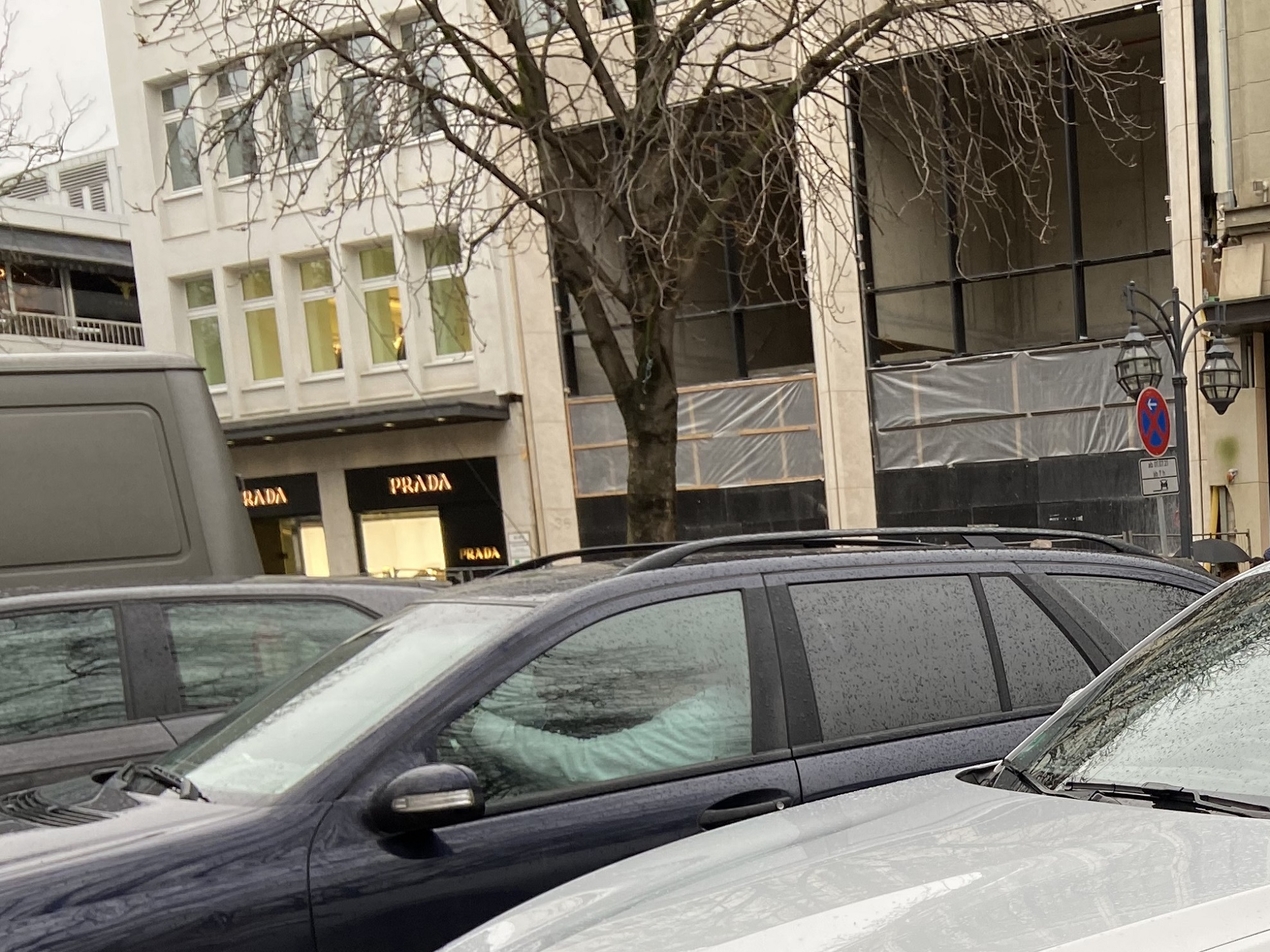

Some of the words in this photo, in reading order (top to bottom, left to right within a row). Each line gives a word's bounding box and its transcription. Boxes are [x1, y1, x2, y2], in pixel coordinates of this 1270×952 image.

[388, 471, 453, 496] PRADA
[242, 485, 288, 507] RADA
[459, 545, 501, 560] PRADA
